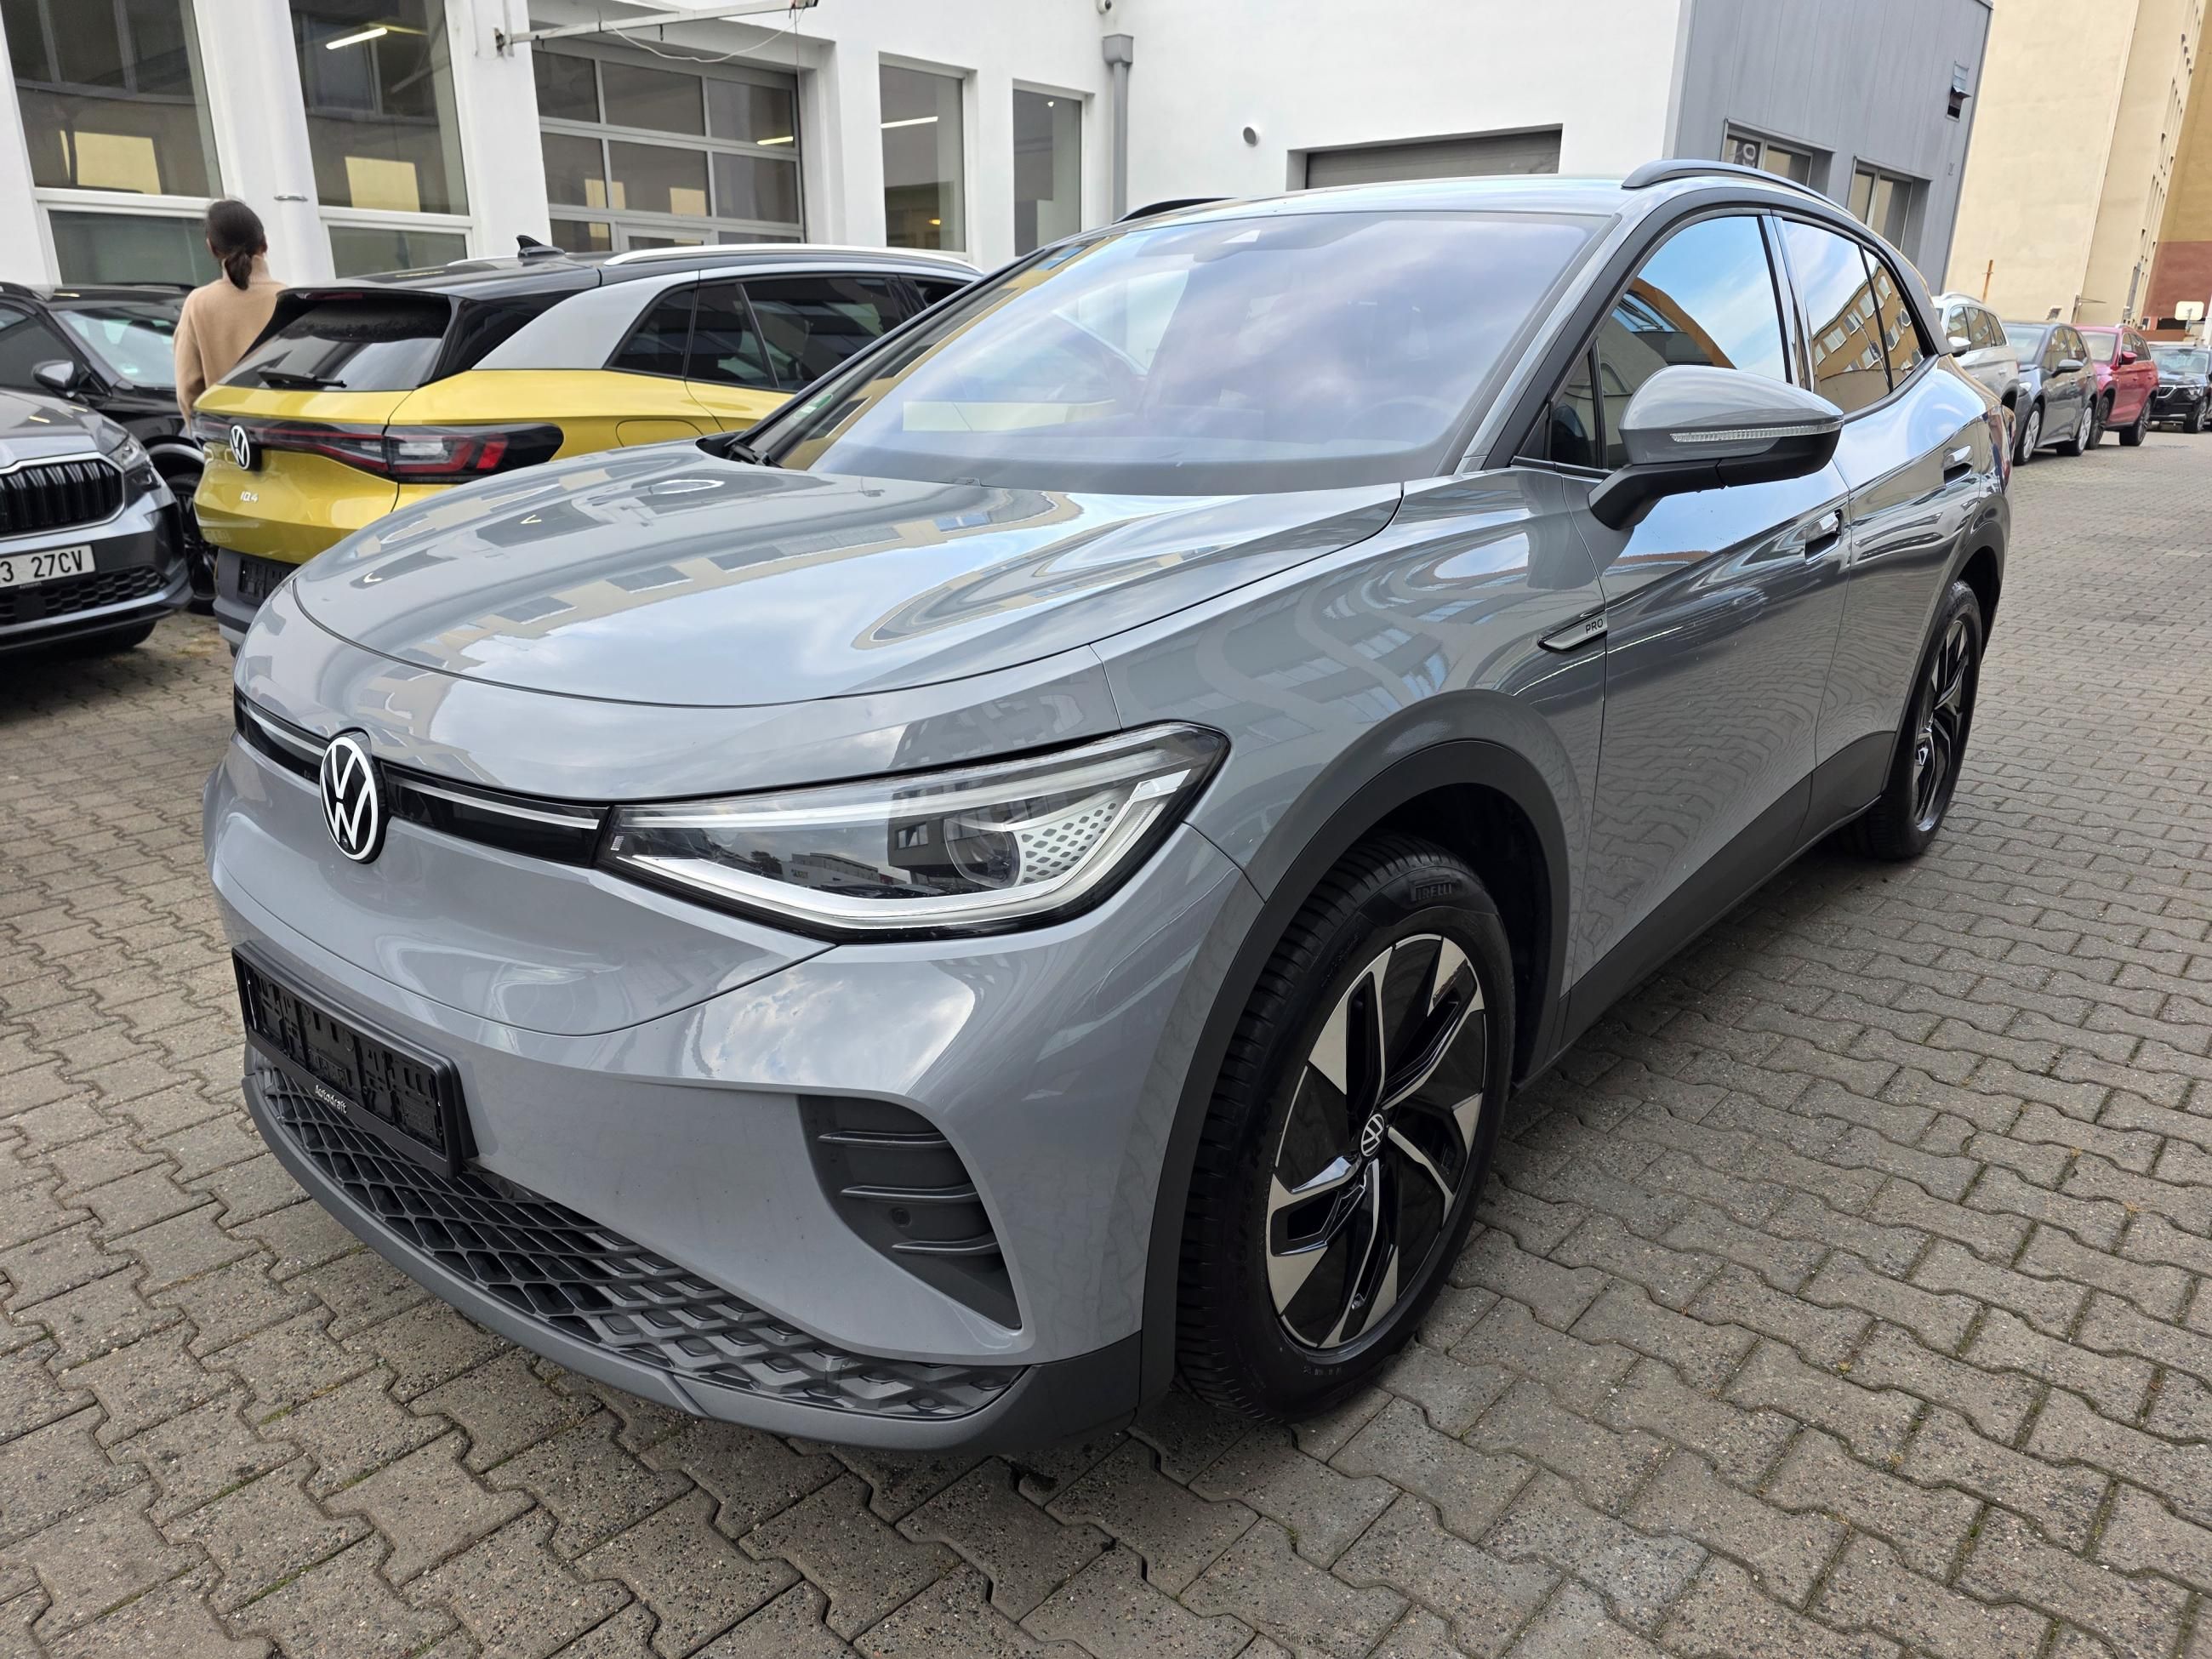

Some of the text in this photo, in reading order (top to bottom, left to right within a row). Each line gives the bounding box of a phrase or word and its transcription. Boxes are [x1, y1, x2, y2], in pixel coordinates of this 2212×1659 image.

[31, 550, 83, 578] 27CV
[1585, 619, 1604, 633] PRO
[1409, 877, 1454, 902] PIRELLI
